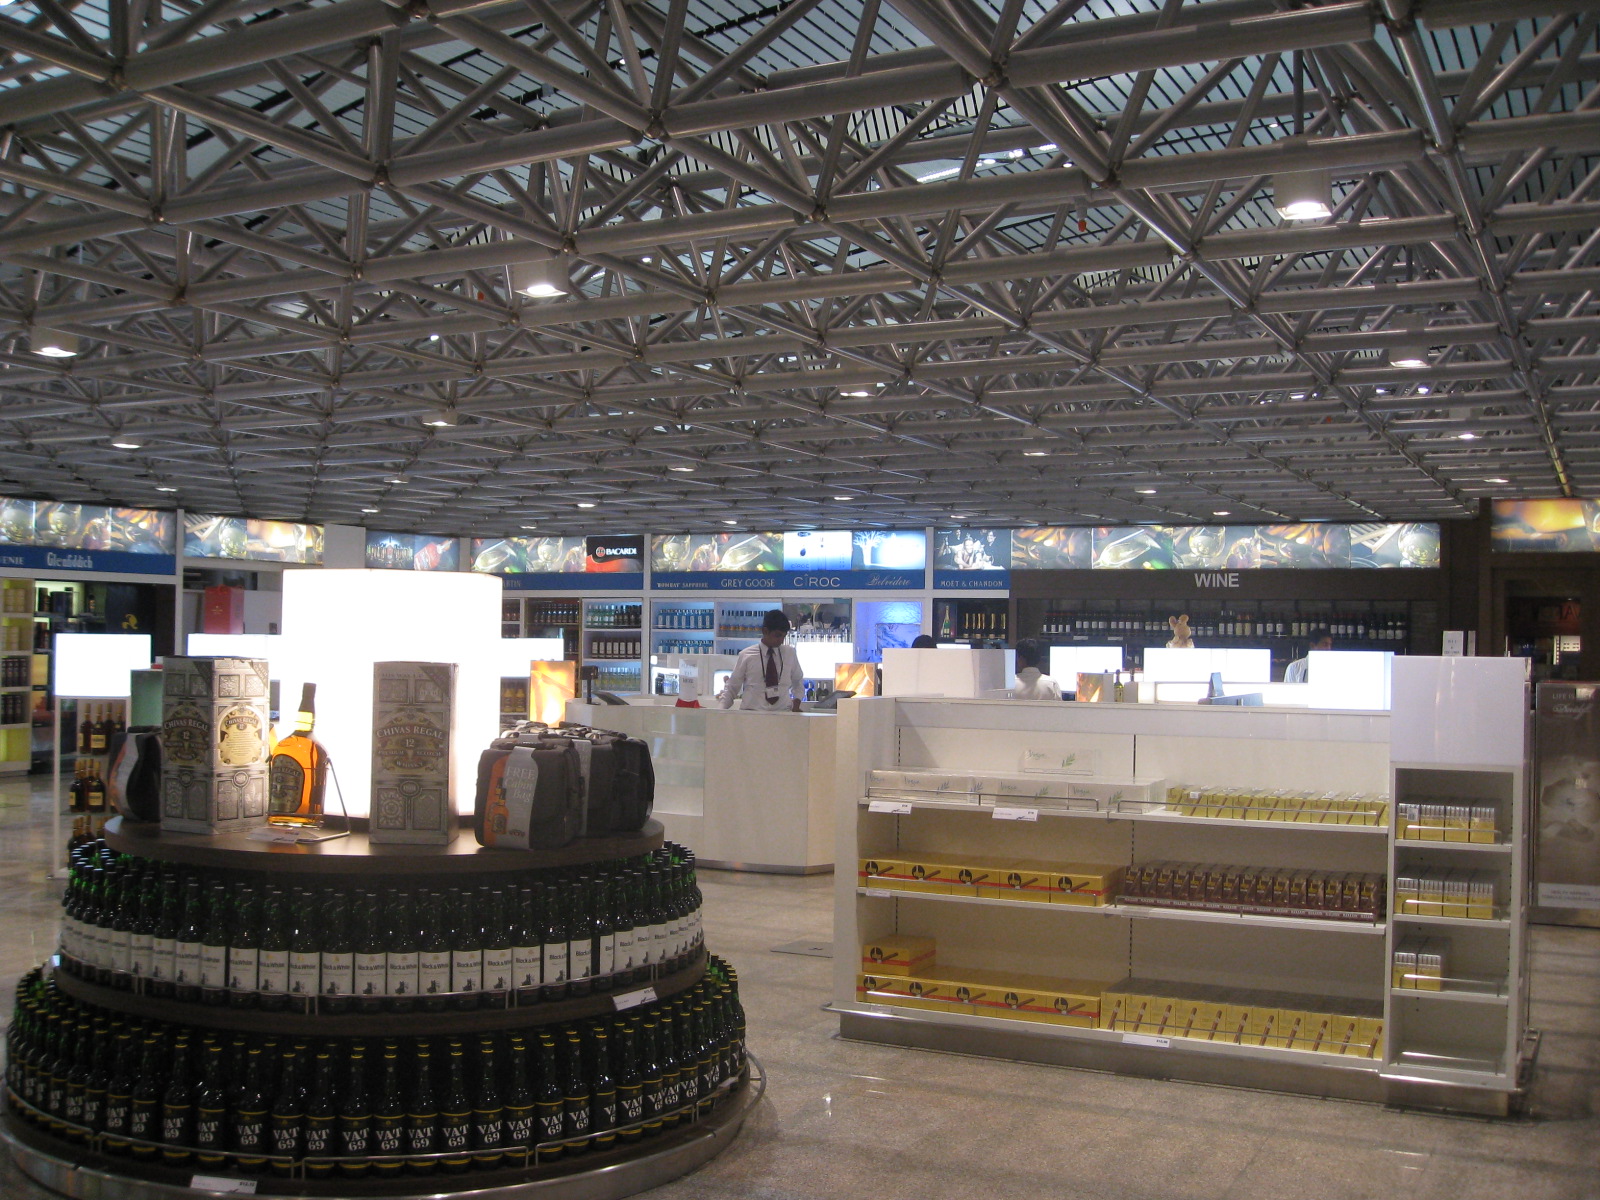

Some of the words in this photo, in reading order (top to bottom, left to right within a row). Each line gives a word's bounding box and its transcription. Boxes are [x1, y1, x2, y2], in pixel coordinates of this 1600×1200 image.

[606, 548, 637, 556] BACARDI
[0, 556, 24, 565] ENIE
[47, 552, 93, 568] Glenfiddich
[721, 578, 744, 588] GREY
[745, 578, 775, 588] GOOSE
[1194, 573, 1239, 587] WINE
[164, 718, 188, 730] CHIVAS
[188, 718, 208, 732] REGAL
[183, 730, 190, 740] 12
[376, 726, 410, 738] CHIVAS
[414, 726, 443, 739] REGAL
[406, 738, 415, 748] 12
[507, 766, 535, 780] FREE
[648, 1092, 662, 1104] VA
[686, 1087, 698, 1098] 69
[665, 1094, 678, 1105] 69
[628, 1106, 642, 1118] 69
[107, 1117, 122, 1128] 69
[507, 1117, 532, 1131] VAT
[540, 1112, 564, 1126] VAT
[576, 1117, 589, 1130] 69
[164, 1128, 179, 1138] 69
[237, 1123, 263, 1135] VAT
[273, 1127, 300, 1140] VAT
[376, 1127, 403, 1140] VAT
[408, 1126, 434, 1139] VAT
[442, 1124, 469, 1137] VAT
[477, 1120, 502, 1135] VAT
[548, 1123, 562, 1136] 69
[199, 1132, 213, 1142] 69
[240, 1135, 258, 1145] 69
[305, 1129, 330, 1140] VAT
[342, 1128, 370, 1141] VAT
[484, 1132, 500, 1144] 69
[513, 1128, 530, 1140] 69
[278, 1138, 295, 1150] 69
[308, 1140, 325, 1151] 69
[348, 1140, 366, 1151] 69
[381, 1139, 398, 1150] 69
[412, 1138, 430, 1148] 69
[448, 1136, 465, 1147] 69
